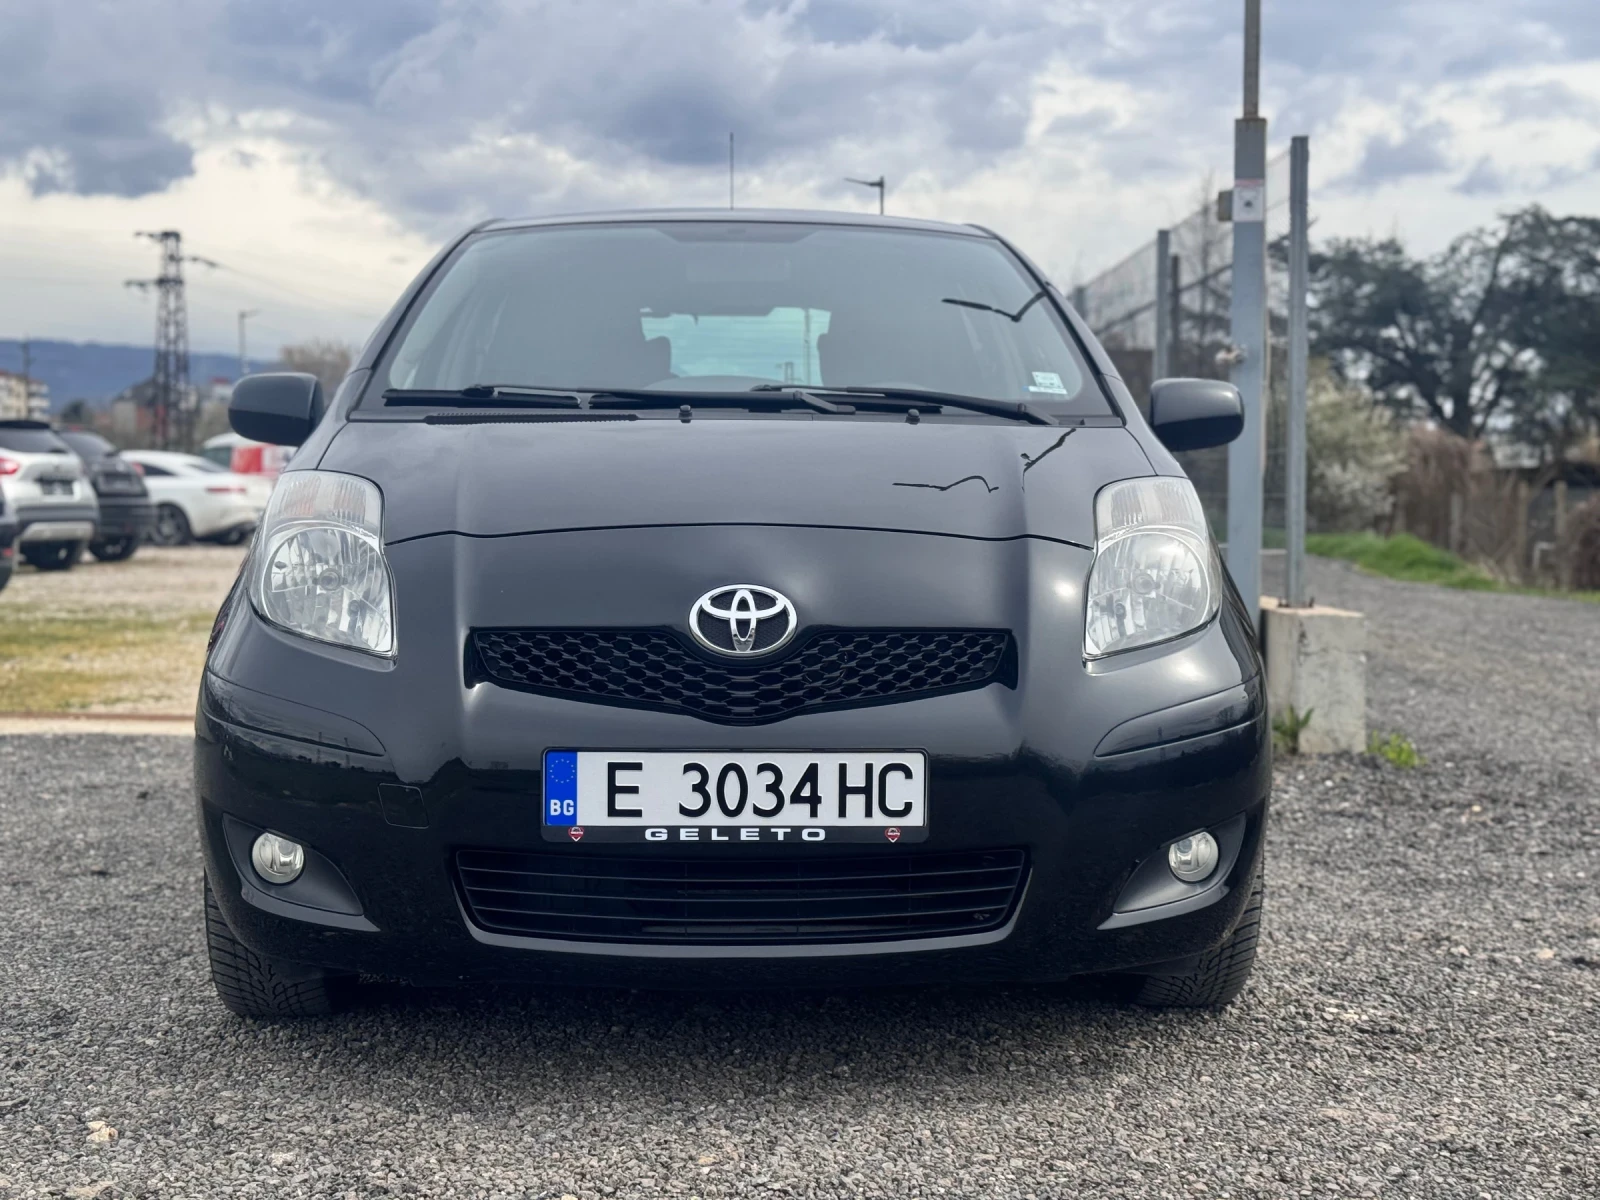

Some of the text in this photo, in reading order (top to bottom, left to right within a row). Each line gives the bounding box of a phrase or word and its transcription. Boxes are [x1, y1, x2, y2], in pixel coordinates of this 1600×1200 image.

[607, 762, 914, 818] E 3034 HC
[549, 799, 575, 816] BG
[644, 828, 826, 841] GELETO
